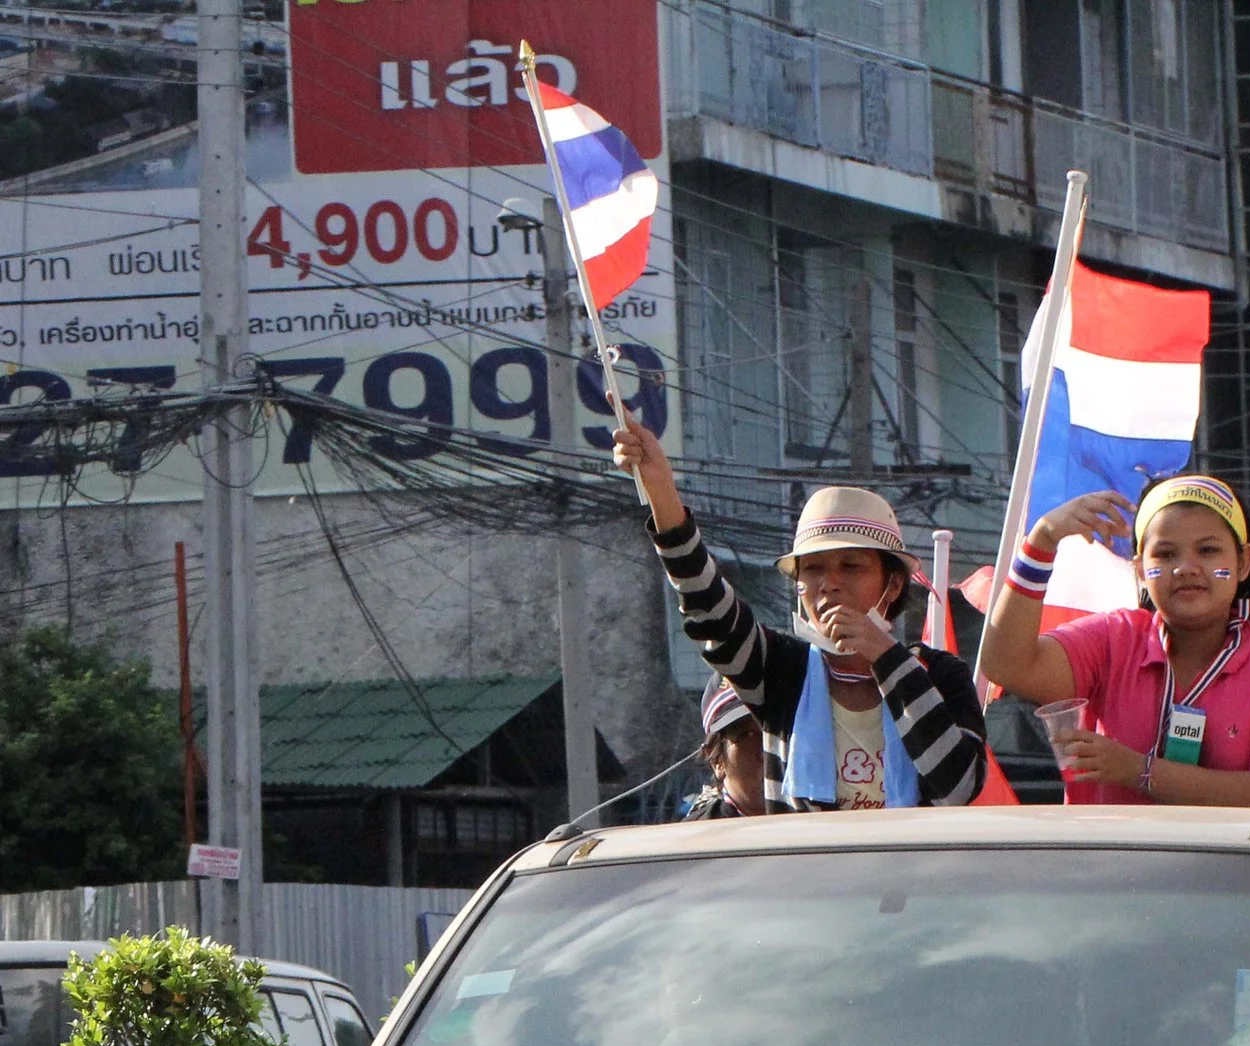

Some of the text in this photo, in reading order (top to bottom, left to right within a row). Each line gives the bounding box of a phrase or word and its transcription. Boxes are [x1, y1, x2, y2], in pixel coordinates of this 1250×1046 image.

[380, 39, 577, 110] แล้ว
[0, 253, 71, 283] บาท
[247, 197, 458, 281] 4,900
[40, 311, 199, 346] เครื่องทำน้ำอุ่
